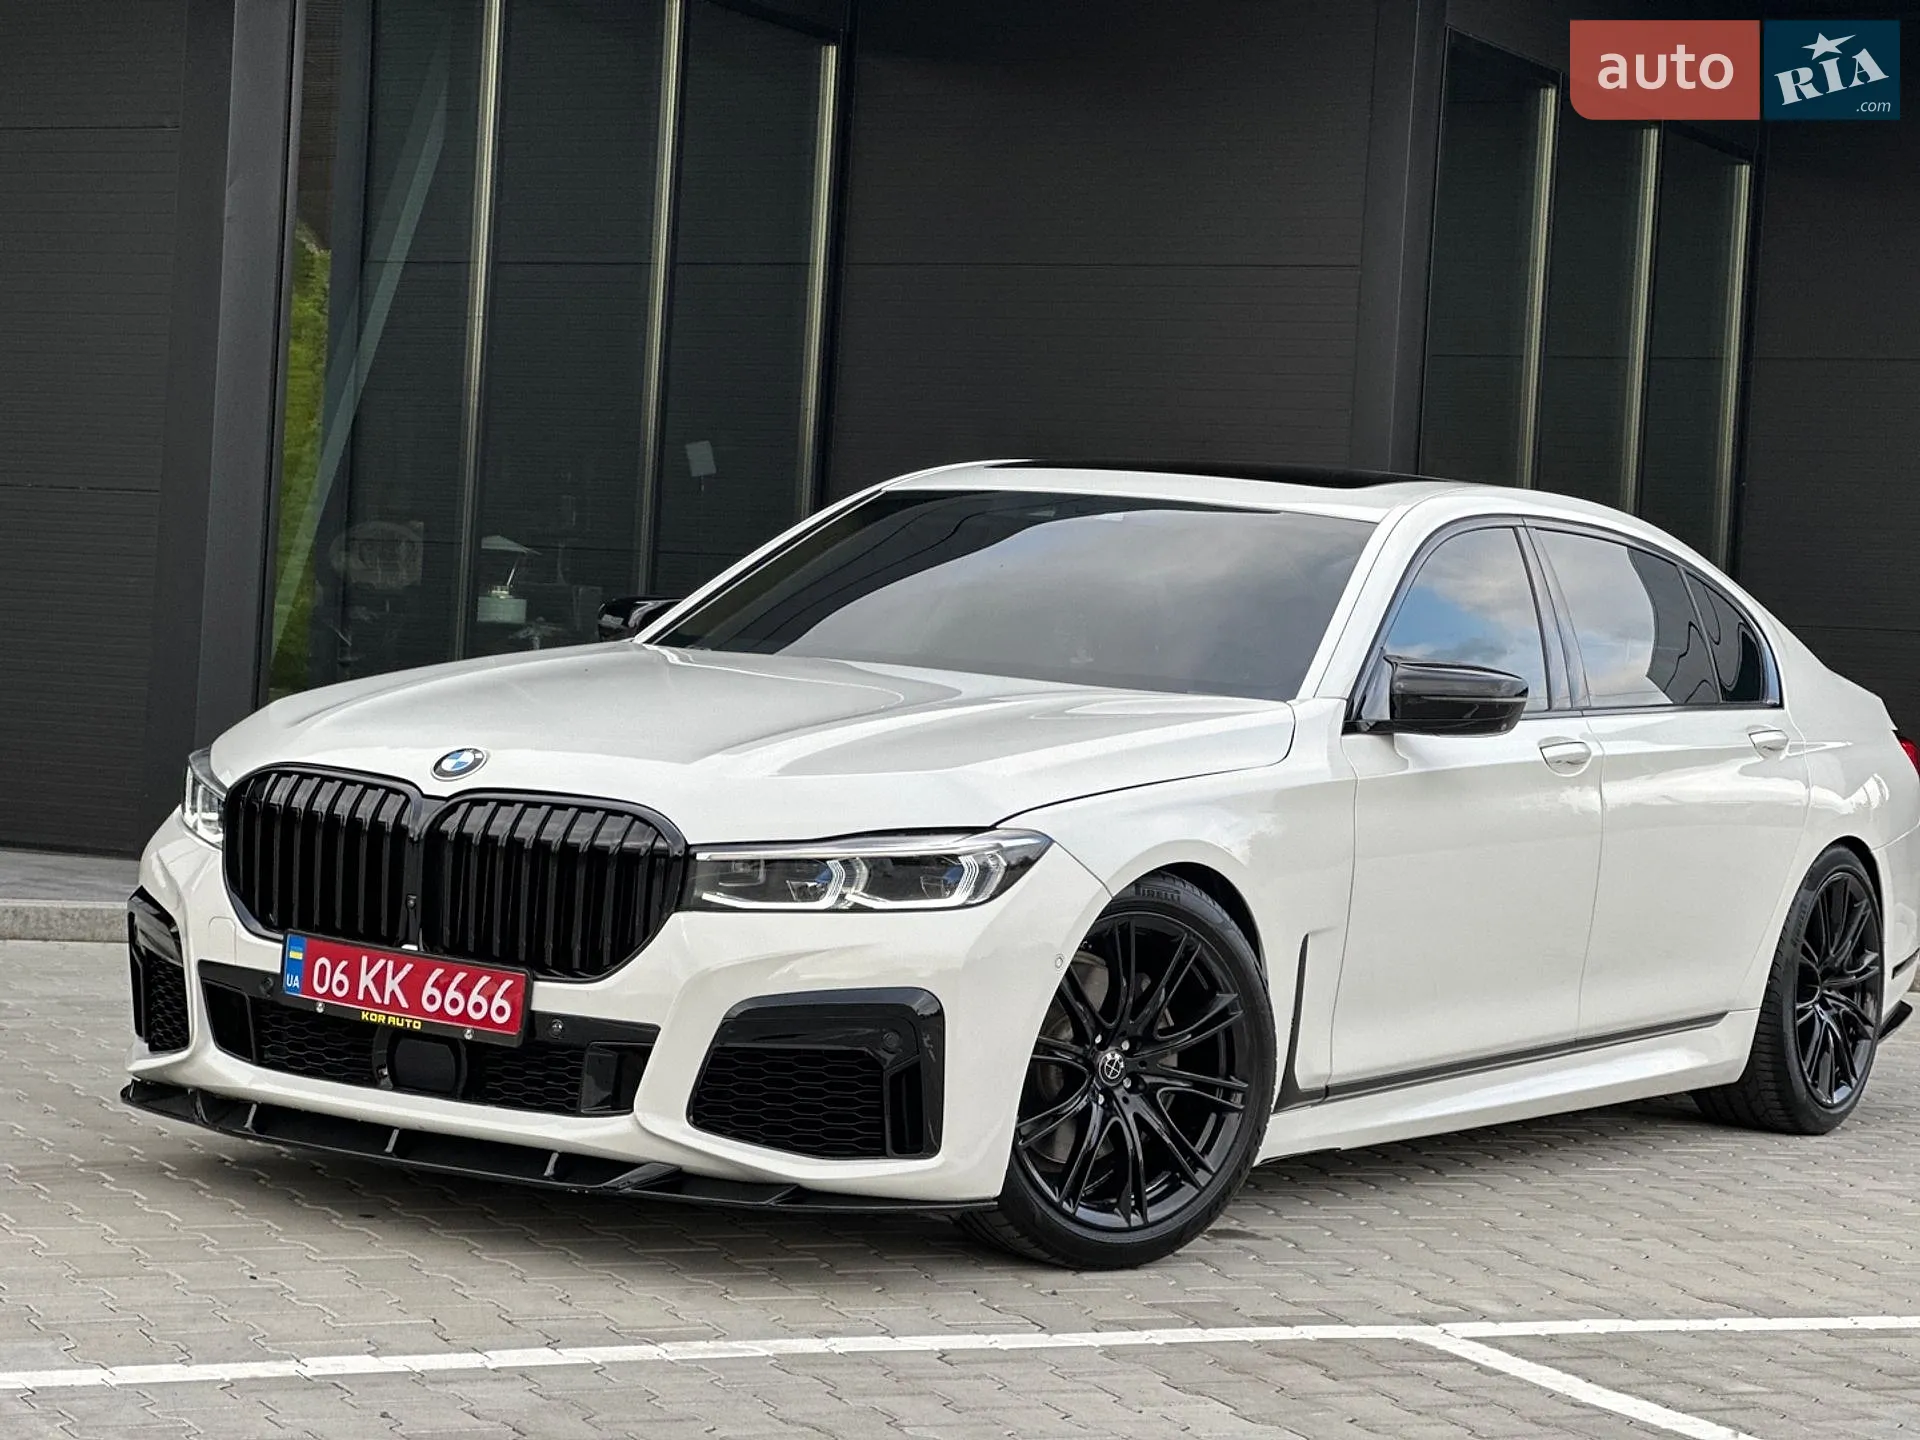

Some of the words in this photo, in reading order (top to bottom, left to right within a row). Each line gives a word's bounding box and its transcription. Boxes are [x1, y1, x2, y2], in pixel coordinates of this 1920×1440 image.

[286, 973, 300, 989] UA
[312, 956, 350, 998] 06
[357, 955, 414, 1009] KK
[421, 967, 514, 1024] 6666
[361, 1010, 386, 1024] KOR
[387, 1015, 422, 1030] AUTO
